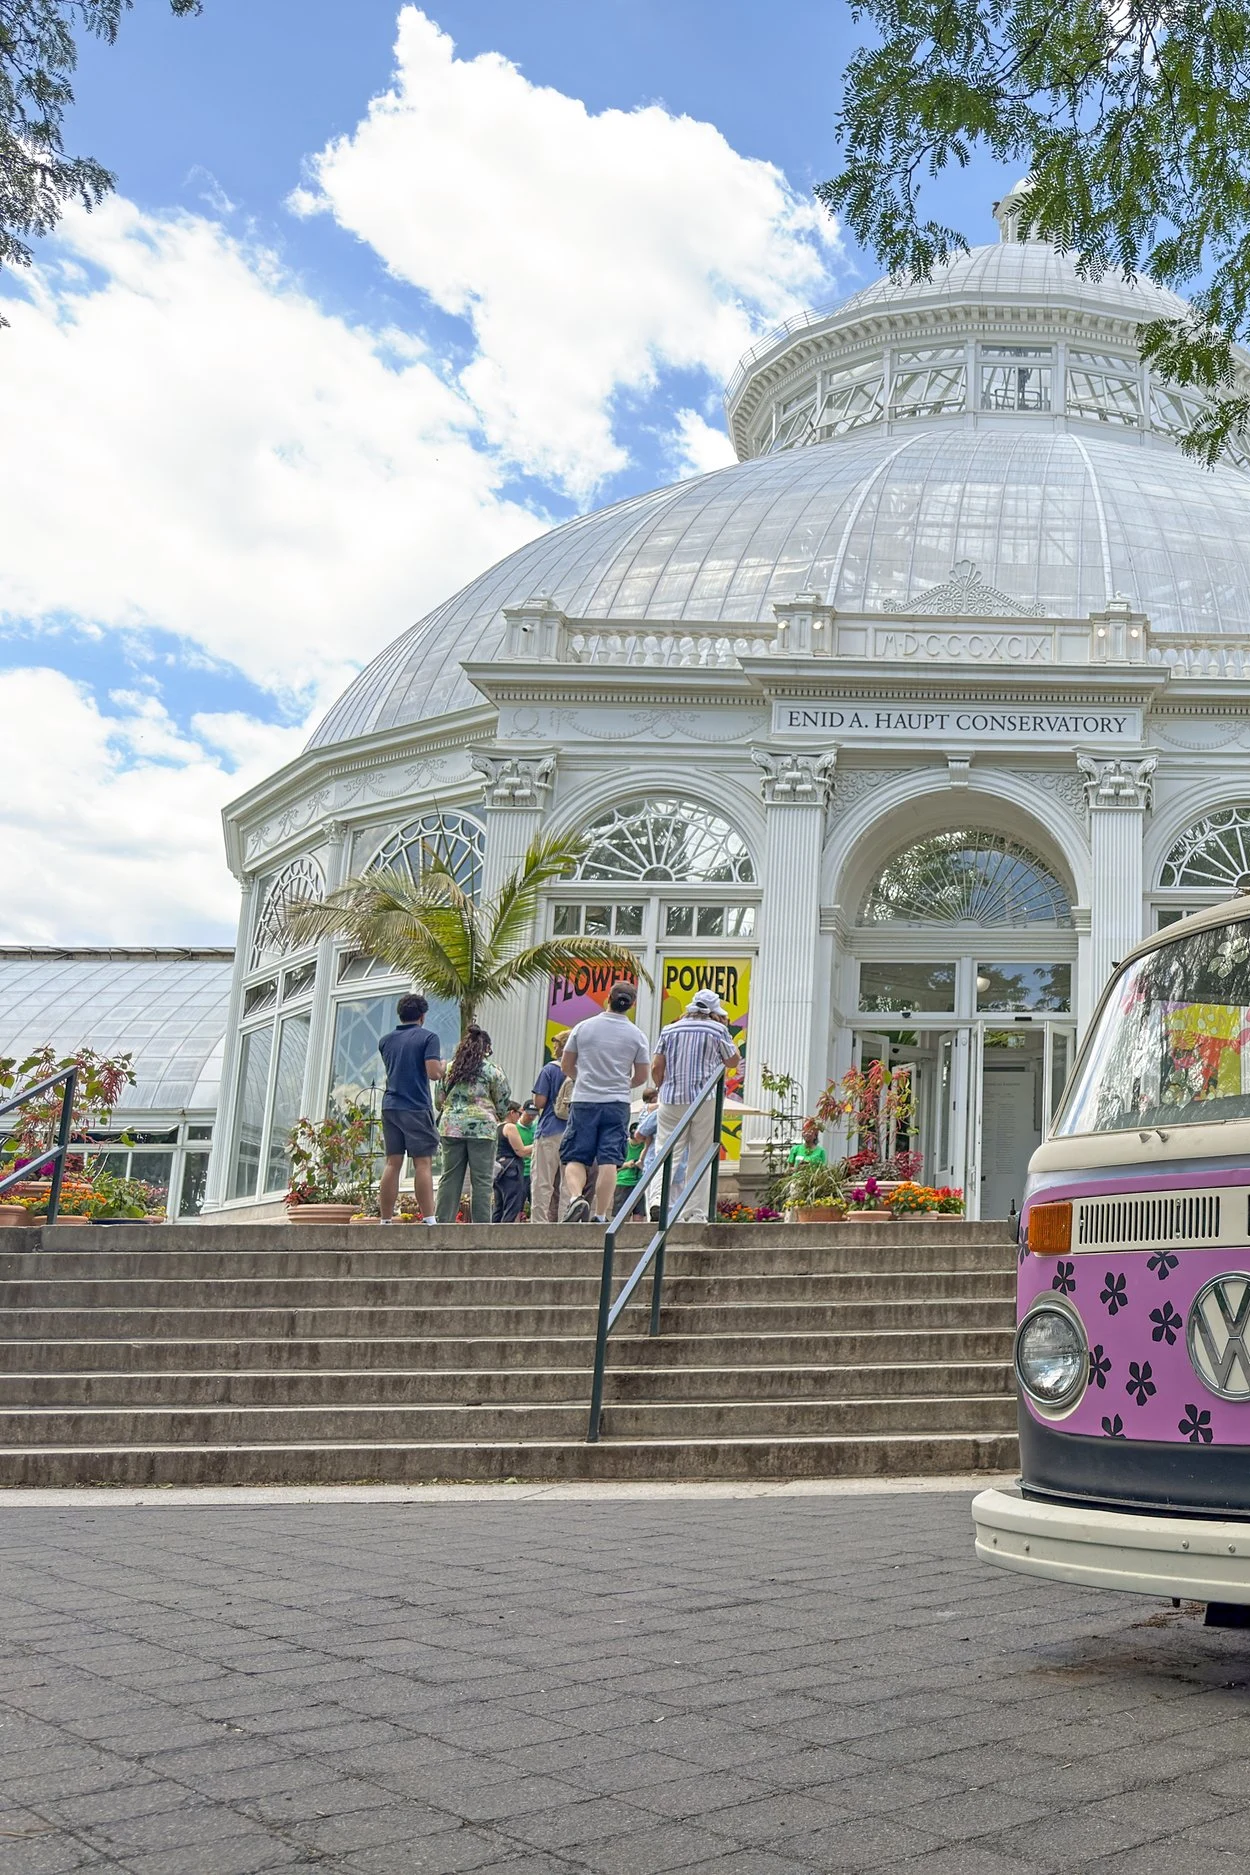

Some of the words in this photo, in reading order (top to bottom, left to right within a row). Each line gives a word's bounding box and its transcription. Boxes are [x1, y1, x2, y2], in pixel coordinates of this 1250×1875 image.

[788, 711, 844, 728] ENID
[848, 712, 869, 729] A.
[875, 713, 950, 730] HAUPT
[956, 714, 1127, 733] CONSERVATORY
[666, 965, 738, 1006] POWER
